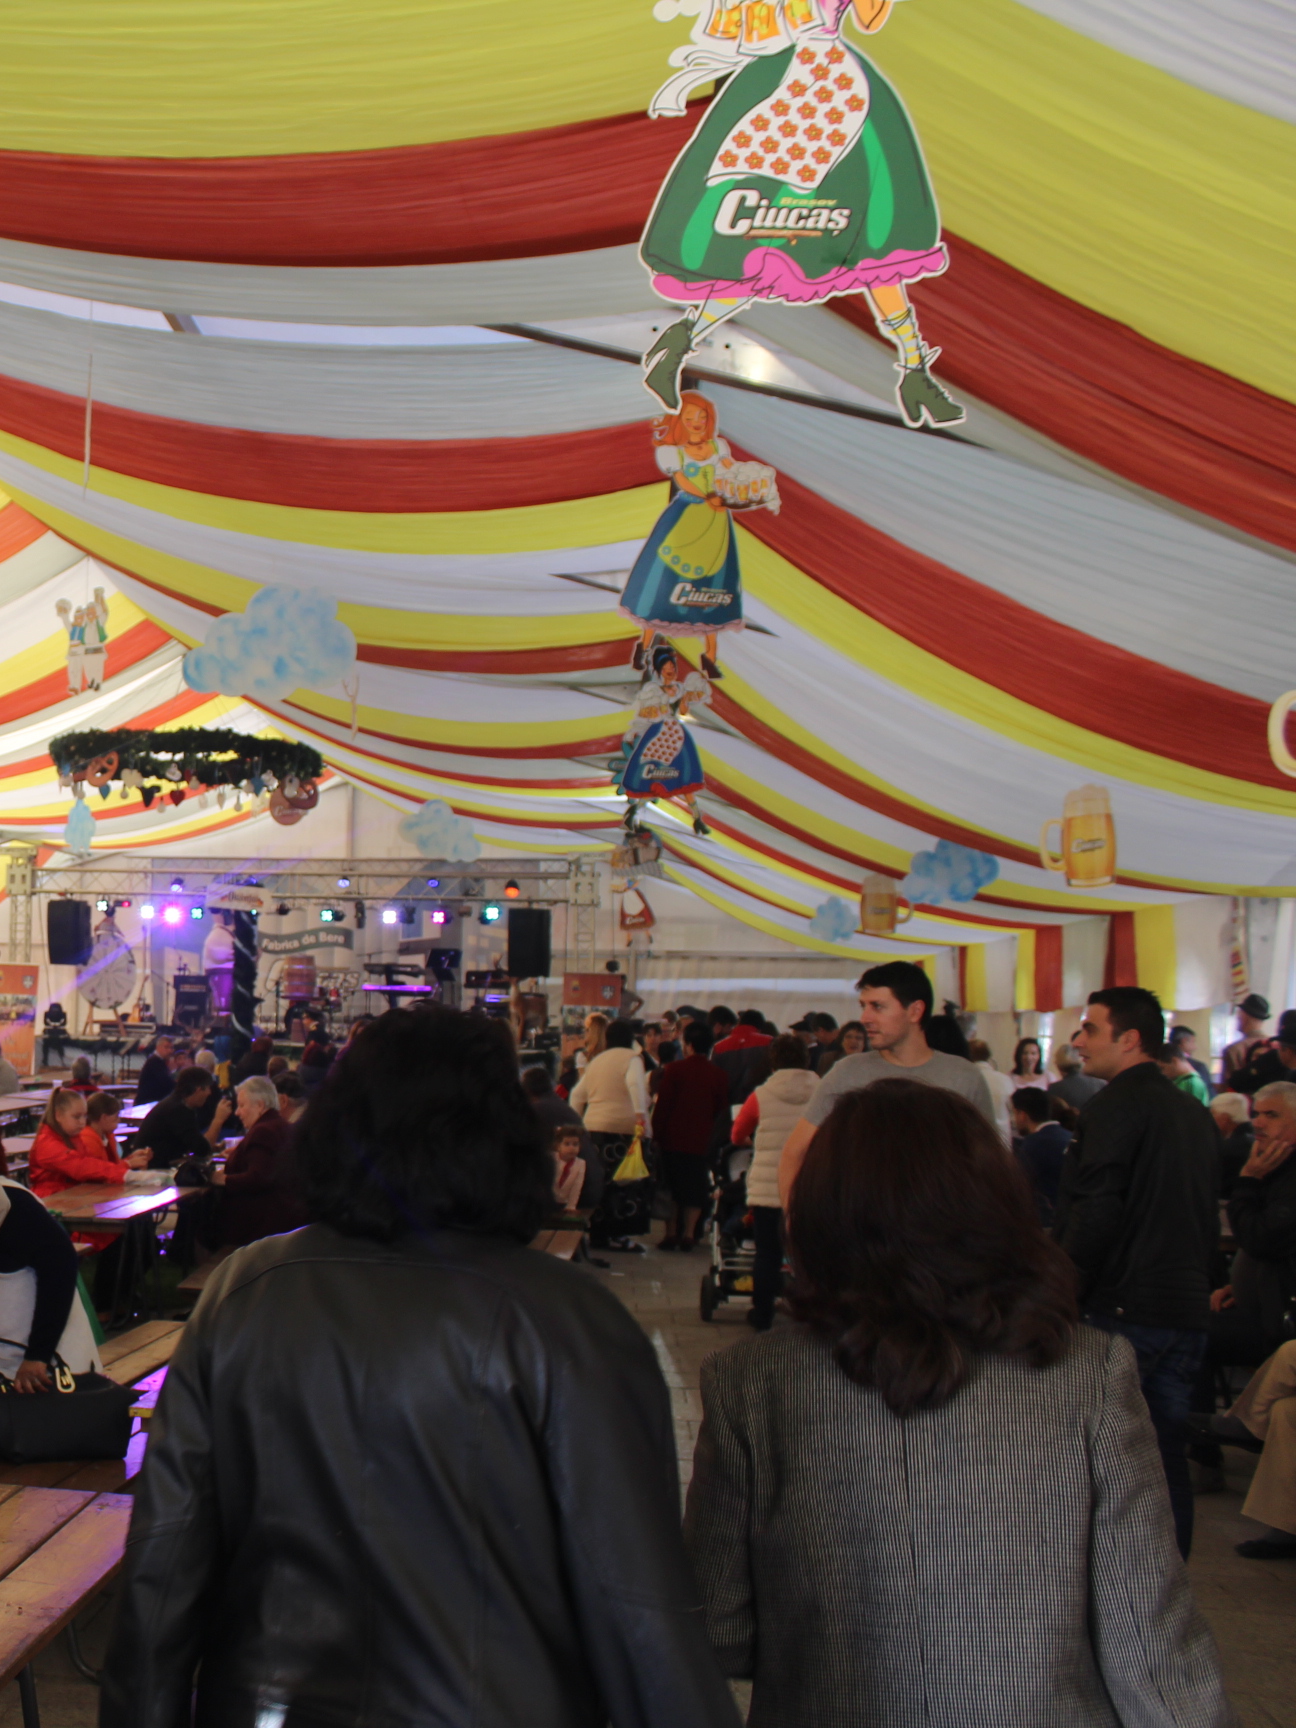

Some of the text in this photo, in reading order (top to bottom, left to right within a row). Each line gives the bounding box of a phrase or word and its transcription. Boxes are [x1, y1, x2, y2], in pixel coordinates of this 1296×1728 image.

[261, 930, 346, 952] Fabrica de Bere
